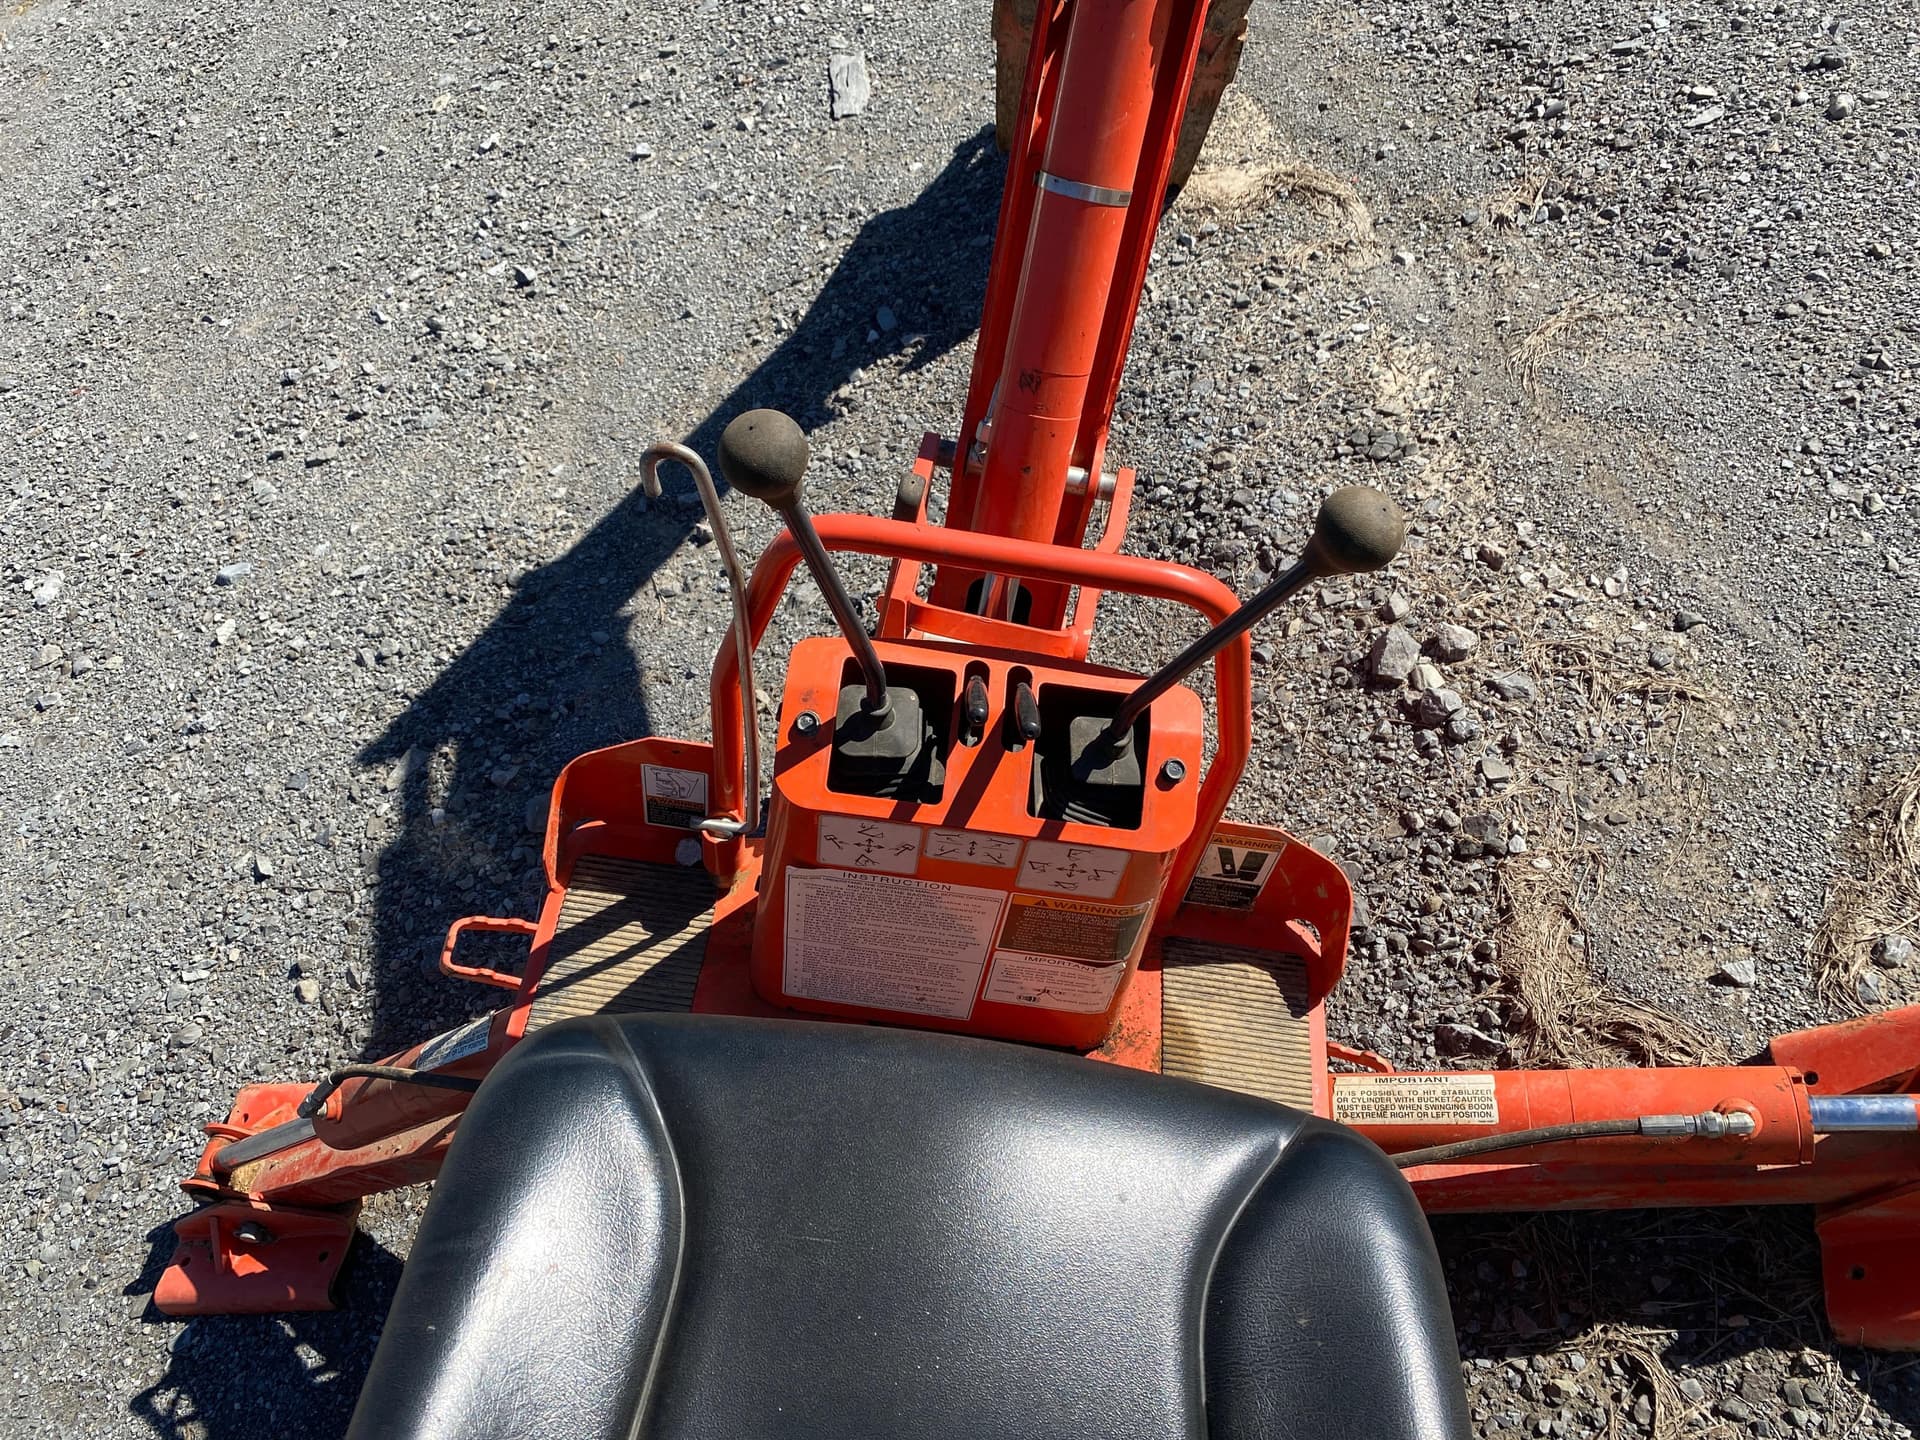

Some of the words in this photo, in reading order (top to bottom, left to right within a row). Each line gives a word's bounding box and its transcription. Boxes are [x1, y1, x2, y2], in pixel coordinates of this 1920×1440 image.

[1226, 838, 1281, 850] WARNING
[842, 871, 952, 891] INSTRUCTION
[1024, 955, 1098, 973] IMPORTANT
[1374, 1076, 1449, 1084] IMPORTANT
[1336, 1096, 1349, 1104] OR
[1350, 1096, 1392, 1104] CYLINDER
[1336, 1104, 1360, 1112] MUST
[1424, 1103, 1466, 1111] SWINGING
[1468, 1103, 1494, 1111] BOOM
[1337, 1111, 1349, 1119] TO
[1350, 1111, 1388, 1119] EXTREME
[1390, 1111, 1414, 1119] RIGHT
[1416, 1111, 1429, 1119] OR
[1430, 1111, 1451, 1119] LEFT
